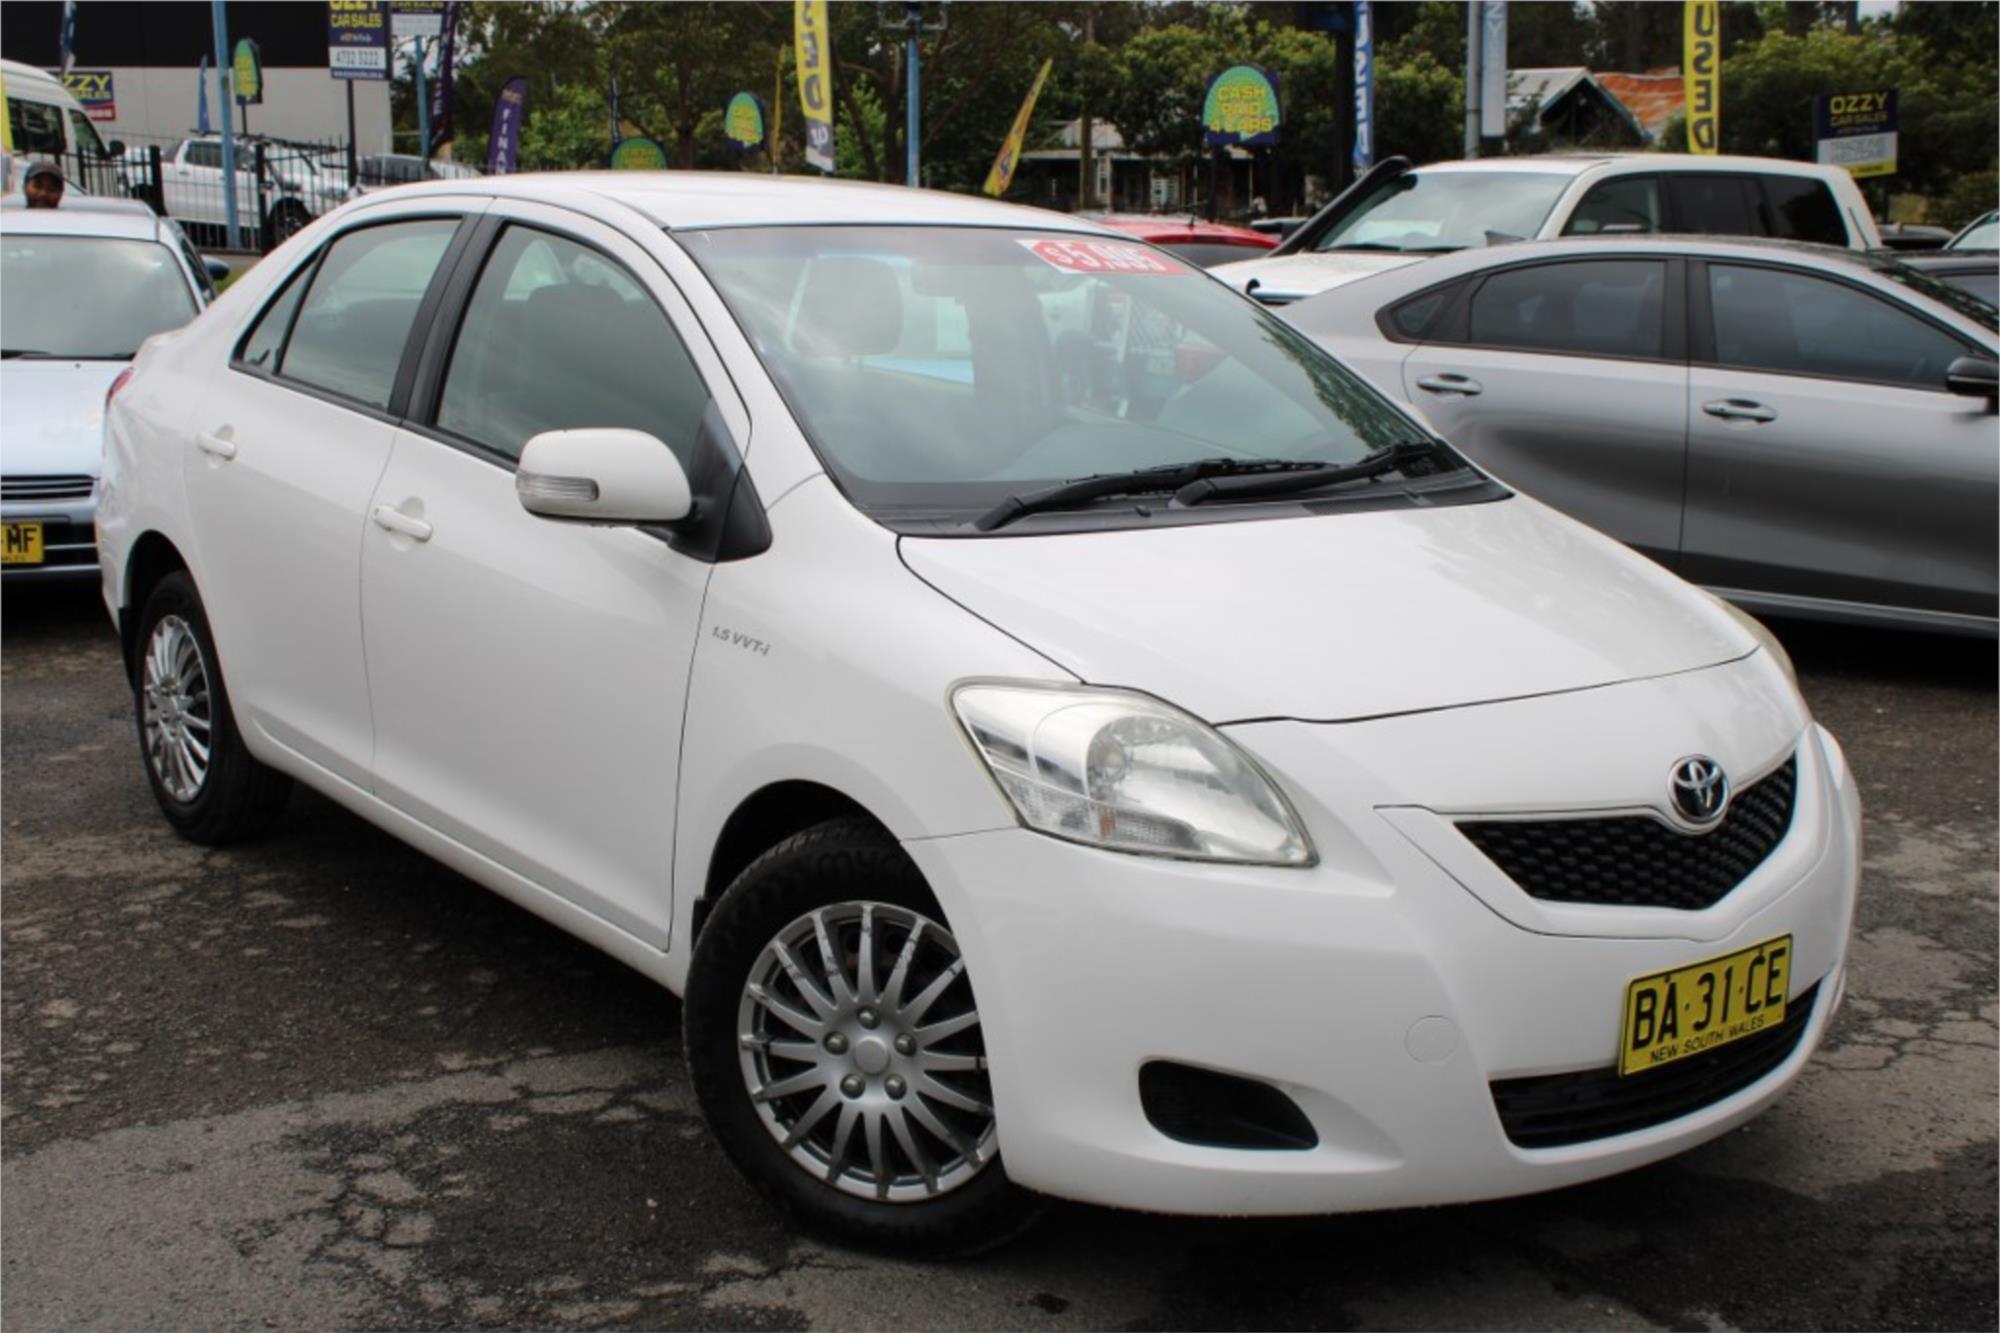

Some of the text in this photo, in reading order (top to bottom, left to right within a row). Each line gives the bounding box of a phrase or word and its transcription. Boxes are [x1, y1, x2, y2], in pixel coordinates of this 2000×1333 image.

[351, 13, 383, 28] SALES
[1219, 86, 1265, 100] CASH
[1830, 92, 1888, 114] OZZY
[733, 631, 771, 656] VVT-i
[1651, 1014, 1765, 1063] NEW SOUTH WALES
